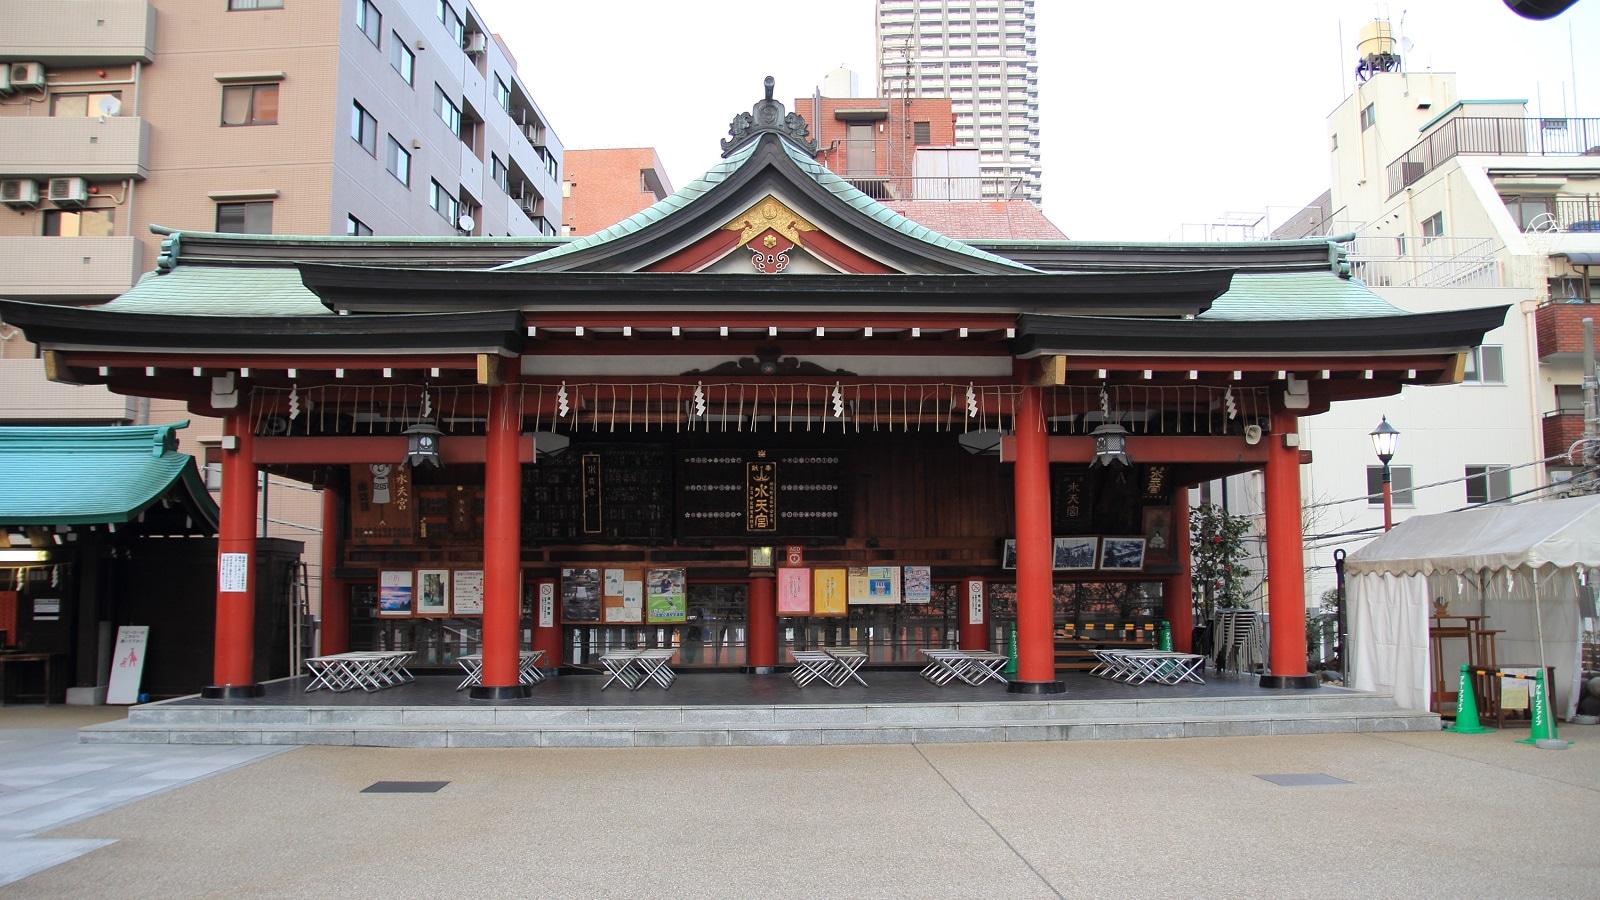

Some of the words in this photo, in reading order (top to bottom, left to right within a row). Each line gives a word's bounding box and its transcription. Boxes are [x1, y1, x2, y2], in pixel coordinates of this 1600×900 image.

[754, 483, 770, 529] 水天宮
[1066, 481, 1081, 518] 水天宮
